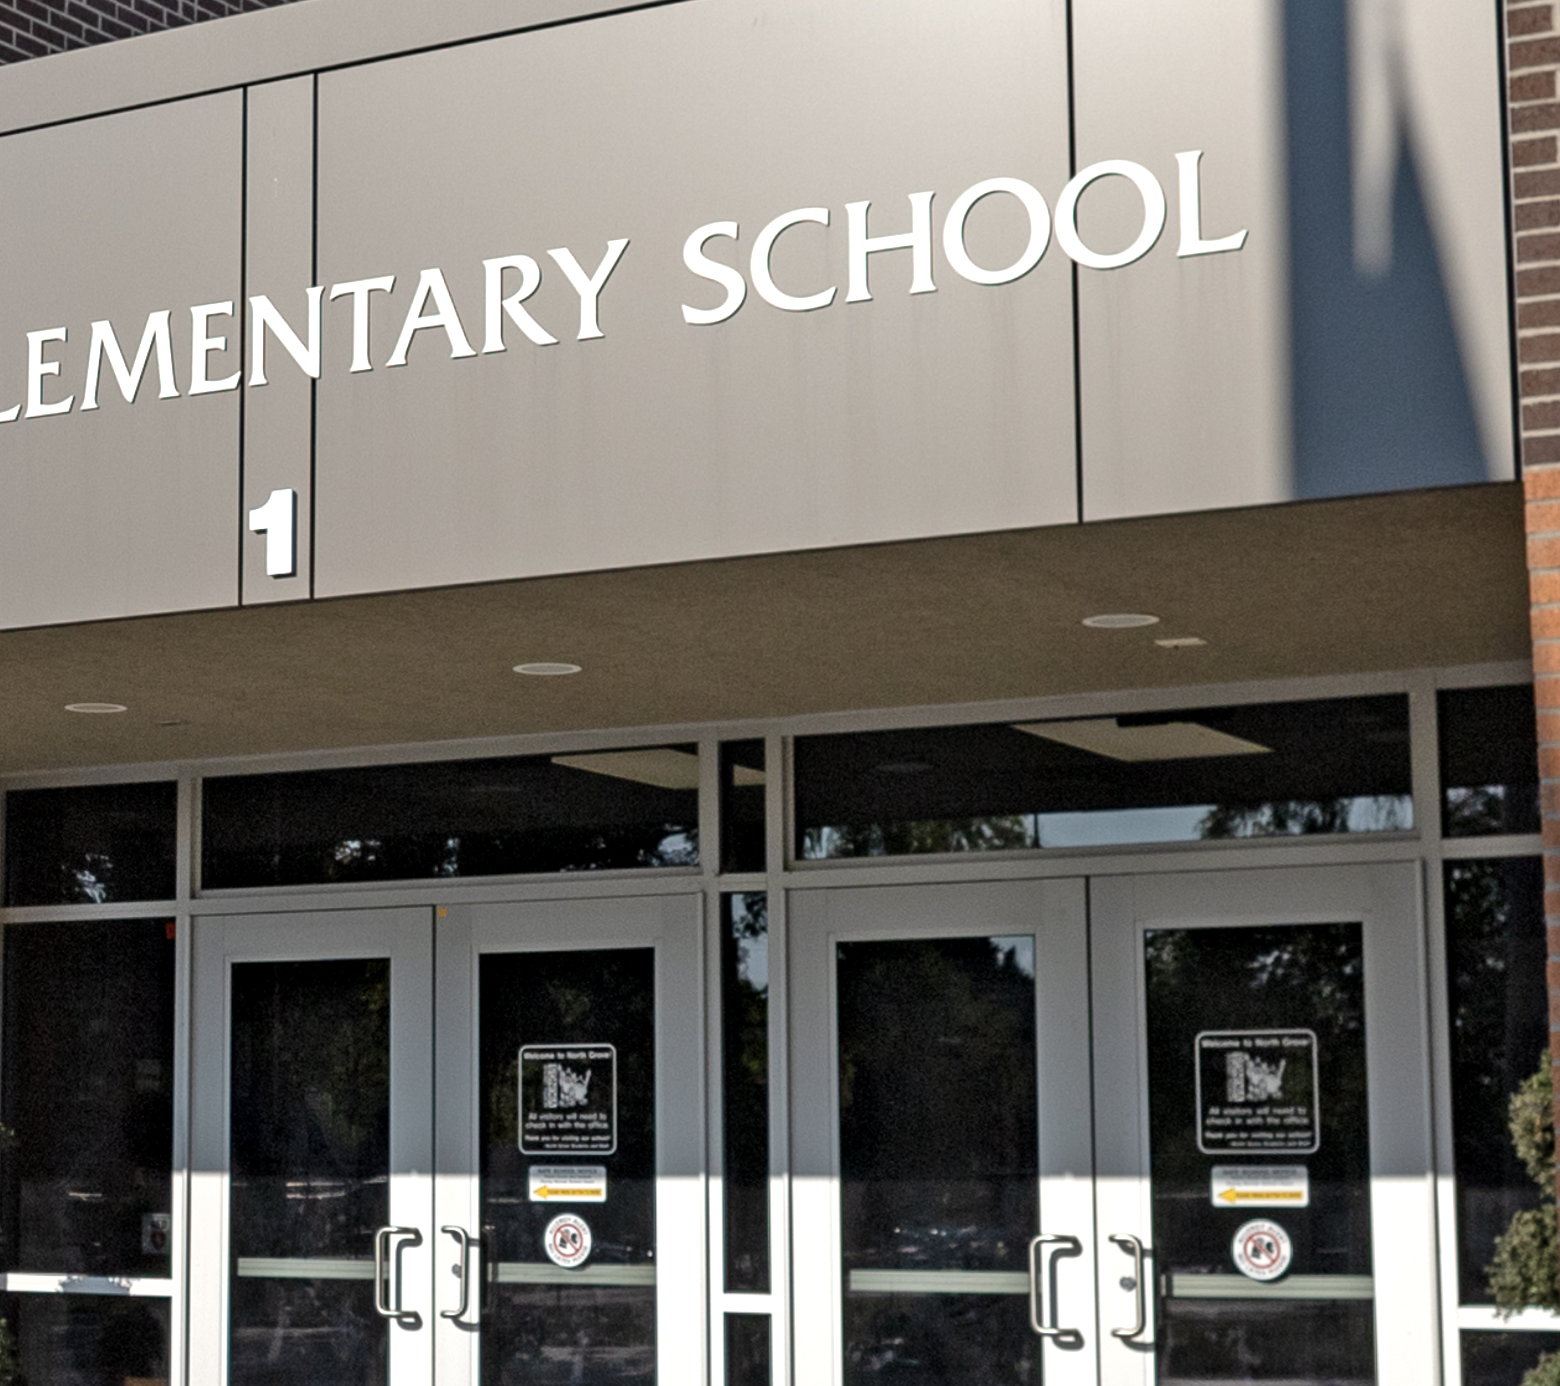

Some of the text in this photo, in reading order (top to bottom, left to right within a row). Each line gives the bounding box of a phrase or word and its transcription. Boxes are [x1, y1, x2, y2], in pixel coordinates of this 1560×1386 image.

[679, 149, 1249, 326] SCHOOL
[248, 488, 296, 578] 1
[567, 1051, 586, 1059] North
